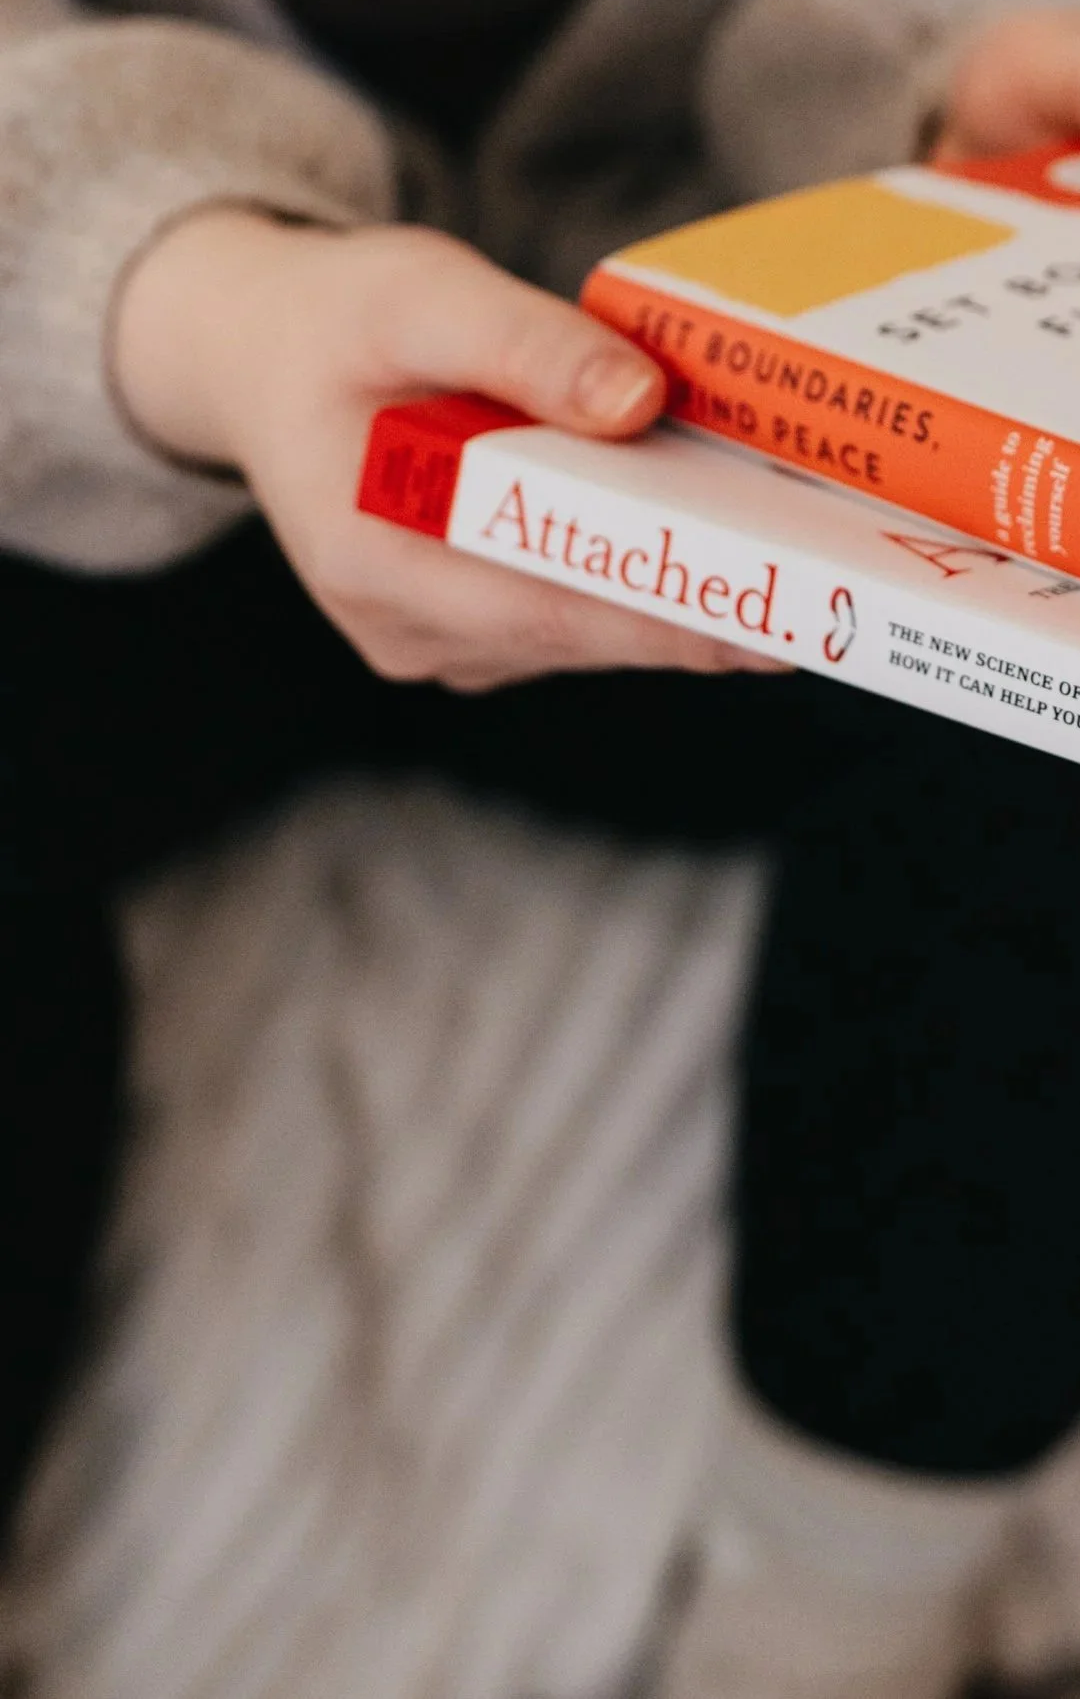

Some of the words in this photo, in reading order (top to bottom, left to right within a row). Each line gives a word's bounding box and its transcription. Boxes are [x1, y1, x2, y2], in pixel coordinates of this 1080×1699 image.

[876, 291, 990, 344] SET
[705, 329, 940, 451] BOUNDARIES,
[772, 414, 883, 484] PEACE
[1001, 430, 1021, 456] to
[990, 459, 1012, 529] guide
[1015, 436, 1056, 558] reclaiming
[1049, 456, 1071, 559] yourself
[481, 479, 797, 645] Attached.
[996, 528, 1010, 543] a
[888, 621, 924, 647] THE
[928, 635, 971, 661] NEW
[975, 652, 1054, 691] SCIENCE
[888, 649, 932, 677] HOW
[935, 666, 955, 684] IT
[959, 674, 995, 699] CAN
[1000, 688, 1048, 715] HELP
